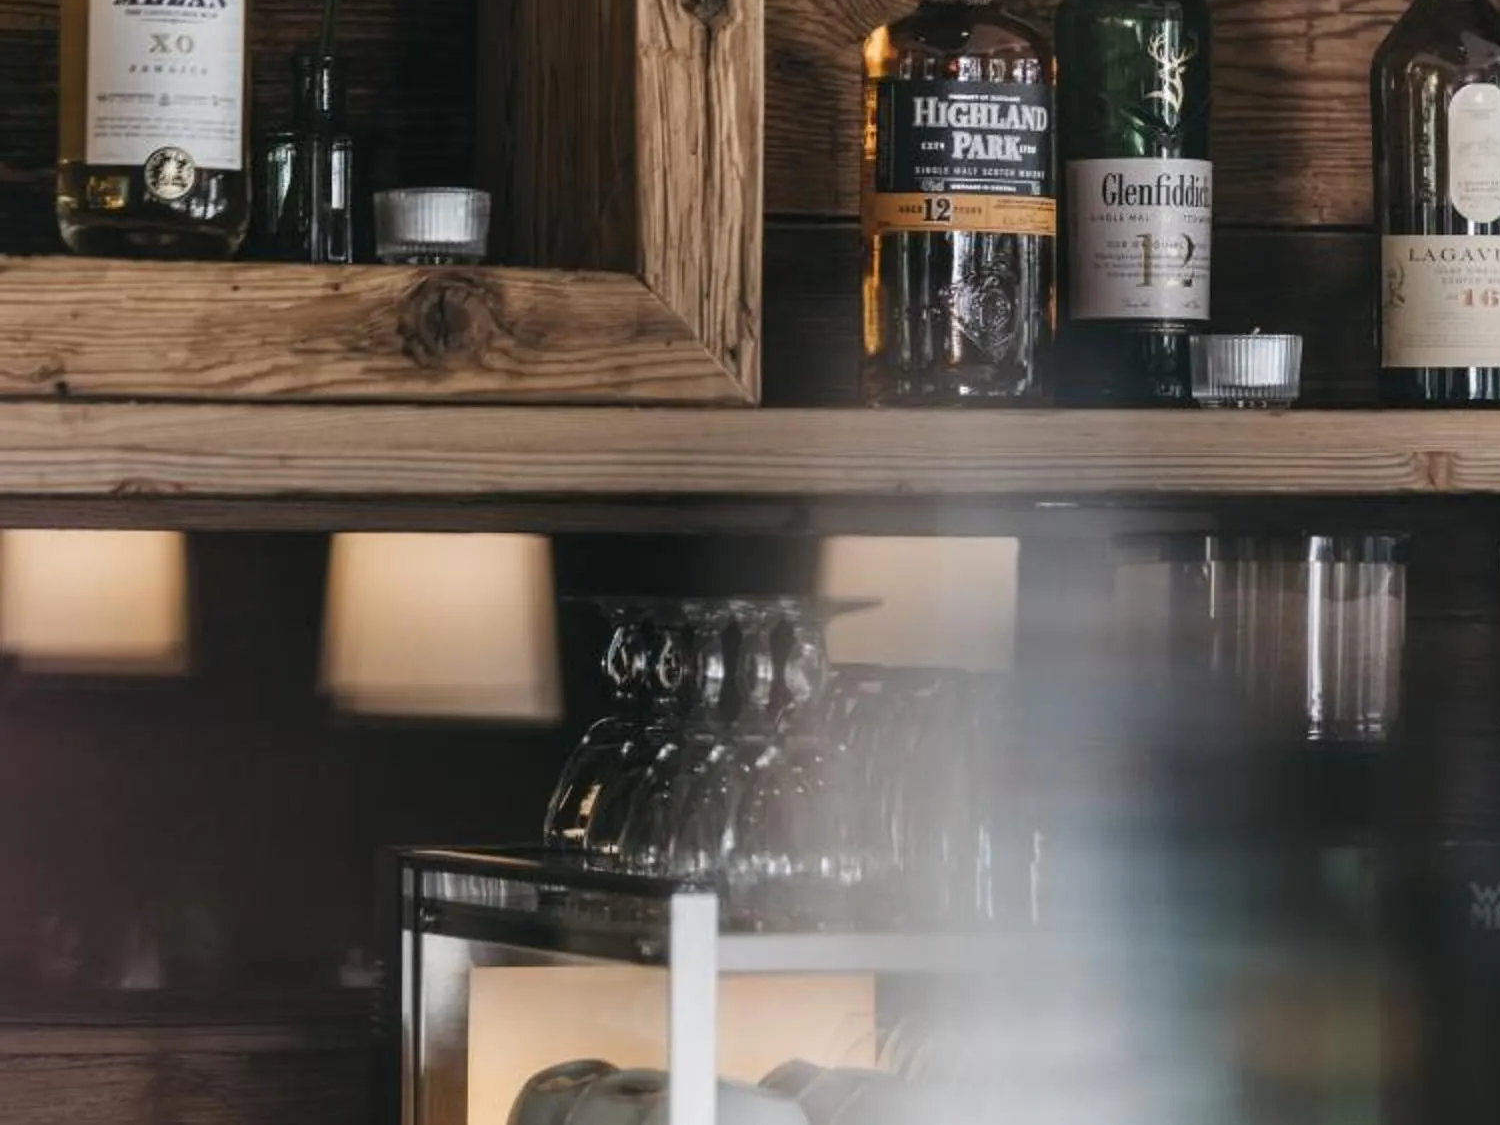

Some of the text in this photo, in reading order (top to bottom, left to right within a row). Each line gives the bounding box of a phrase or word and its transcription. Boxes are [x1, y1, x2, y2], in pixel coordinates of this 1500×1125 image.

[149, 33, 195, 55] XO
[912, 97, 1048, 132] HIGHLAND
[951, 131, 1023, 162] PARK
[923, 198, 952, 222] 12
[1461, 288, 1500, 308] 16
